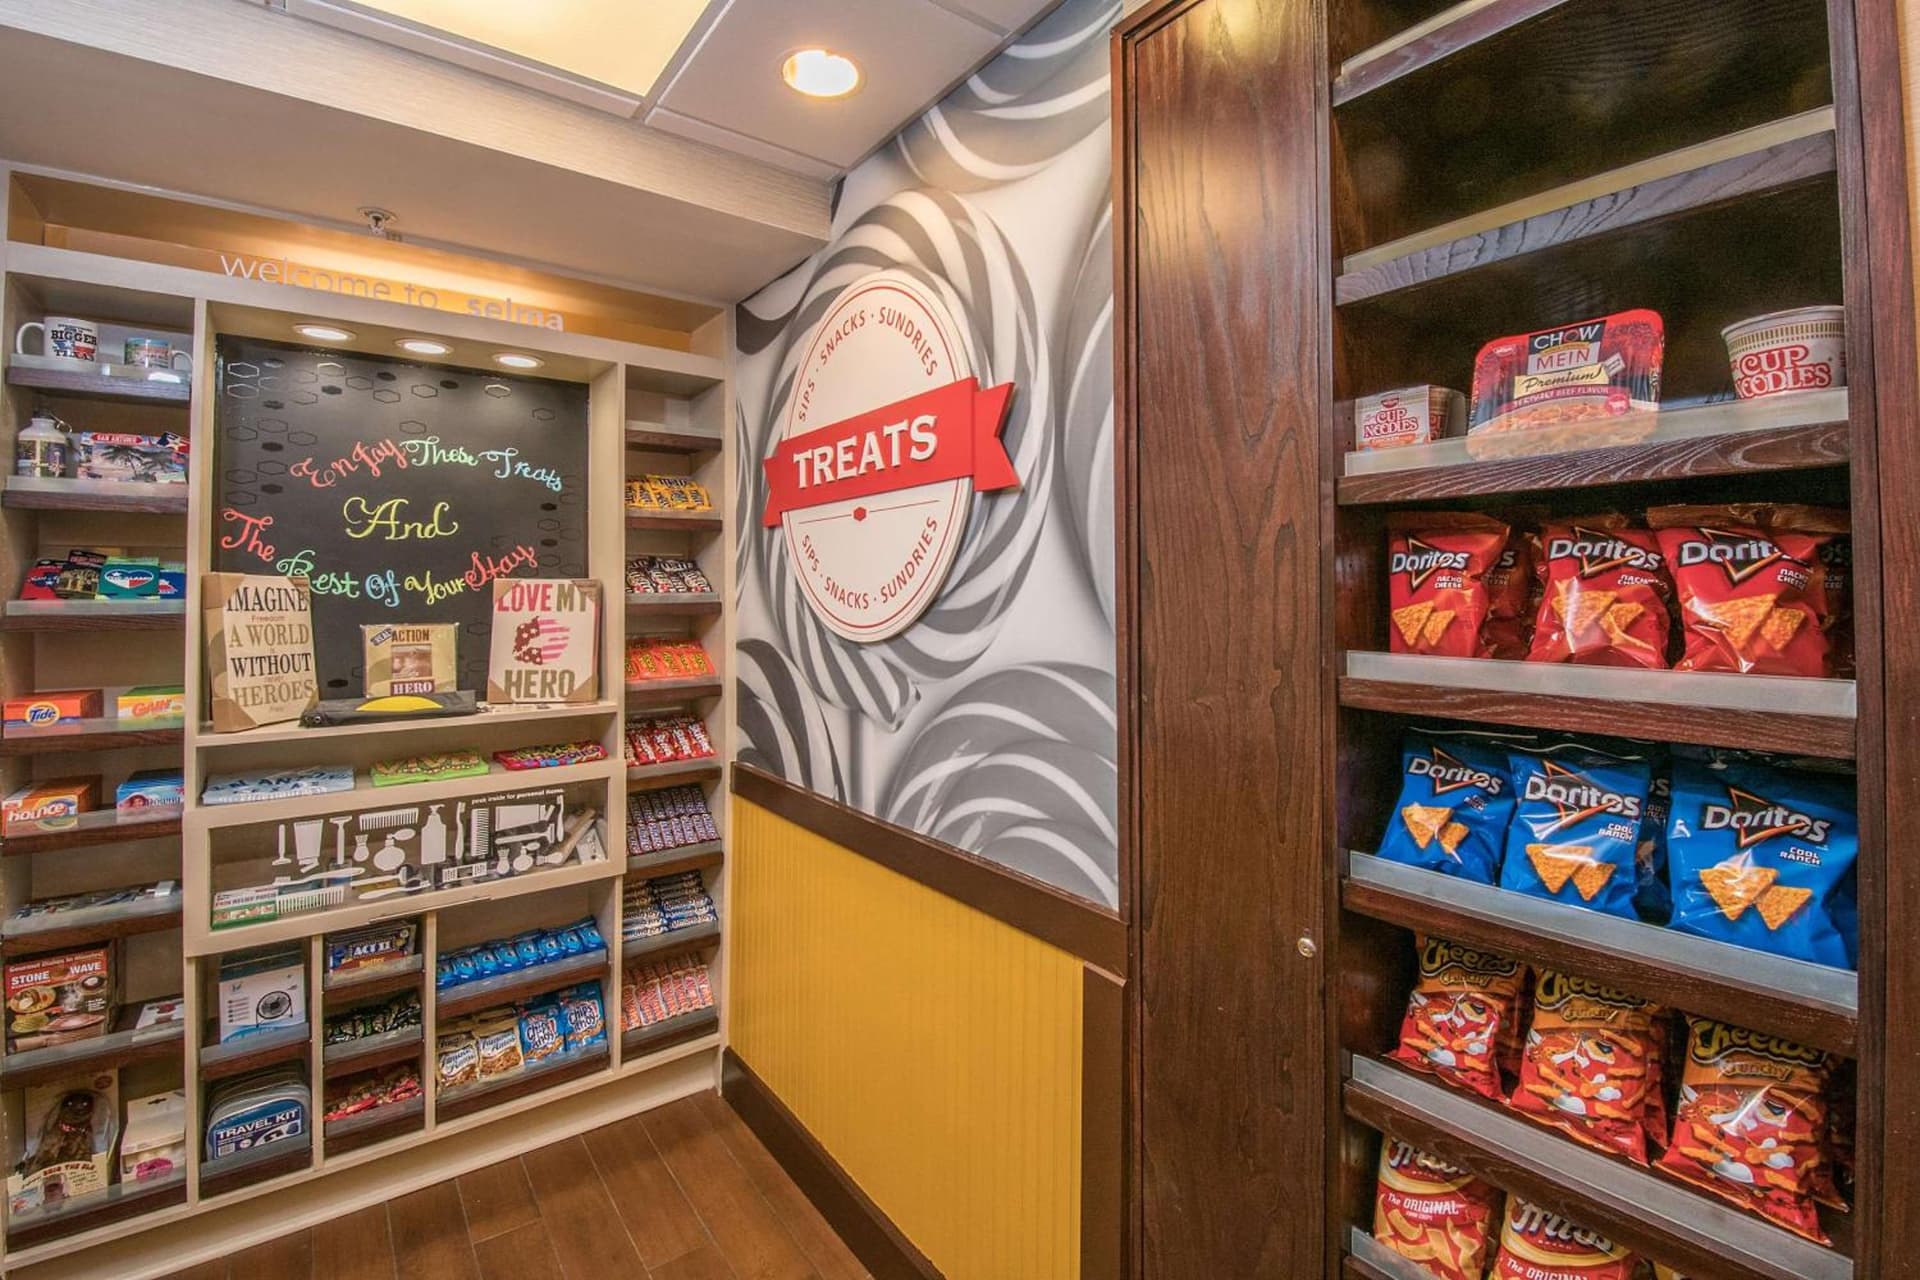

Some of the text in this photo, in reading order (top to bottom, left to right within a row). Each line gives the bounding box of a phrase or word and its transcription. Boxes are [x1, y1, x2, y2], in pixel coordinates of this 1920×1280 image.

[219, 253, 564, 332] welcome to selma
[51, 330, 97, 345] BIGGER
[1534, 324, 1601, 350] CHOW
[798, 306, 938, 422] SIPS SNACKS SUNDRIES
[1536, 349, 1590, 371] MEIN
[1740, 344, 1809, 377] CUP
[1521, 368, 1603, 393] Premium
[1363, 416, 1419, 438] NOODLES
[1375, 408, 1407, 424] CUP
[399, 436, 478, 467] These
[479, 447, 563, 492] Treats
[793, 414, 938, 489] TREATS
[344, 496, 458, 540] And
[220, 508, 275, 561] The
[801, 517, 938, 610] SIPS SNACKS SUNDRIES
[1391, 551, 1470, 573] Doritos
[1551, 539, 1662, 571] Doritos
[1682, 539, 1796, 565] Dorit
[276, 545, 538, 608] Best Of Your Stay
[226, 586, 309, 612] IMAGINE
[495, 582, 553, 612] LOVE
[228, 622, 310, 648] A WORLD
[391, 628, 430, 642] ACTION
[230, 652, 312, 678] WITHOUT
[231, 679, 314, 707] HEROES
[393, 681, 433, 695] HERO
[503, 669, 575, 699] HERO
[29, 708, 57, 722] Tide
[1408, 757, 1503, 795] Doritos
[1524, 776, 1641, 817] Doritos
[8, 802, 64, 822] bounce
[1703, 805, 1831, 843] Doritos
[1607, 822, 1634, 834] COOL
[1779, 850, 1821, 865] RANCH
[1789, 846, 1819, 859] COOL
[11, 961, 102, 987] STONE WAVE
[215, 1110, 299, 1140] TRAVEL KIT
[1403, 1198, 1459, 1215] ORIGINAL
[1507, 1257, 1589, 1280] The ORIGI
